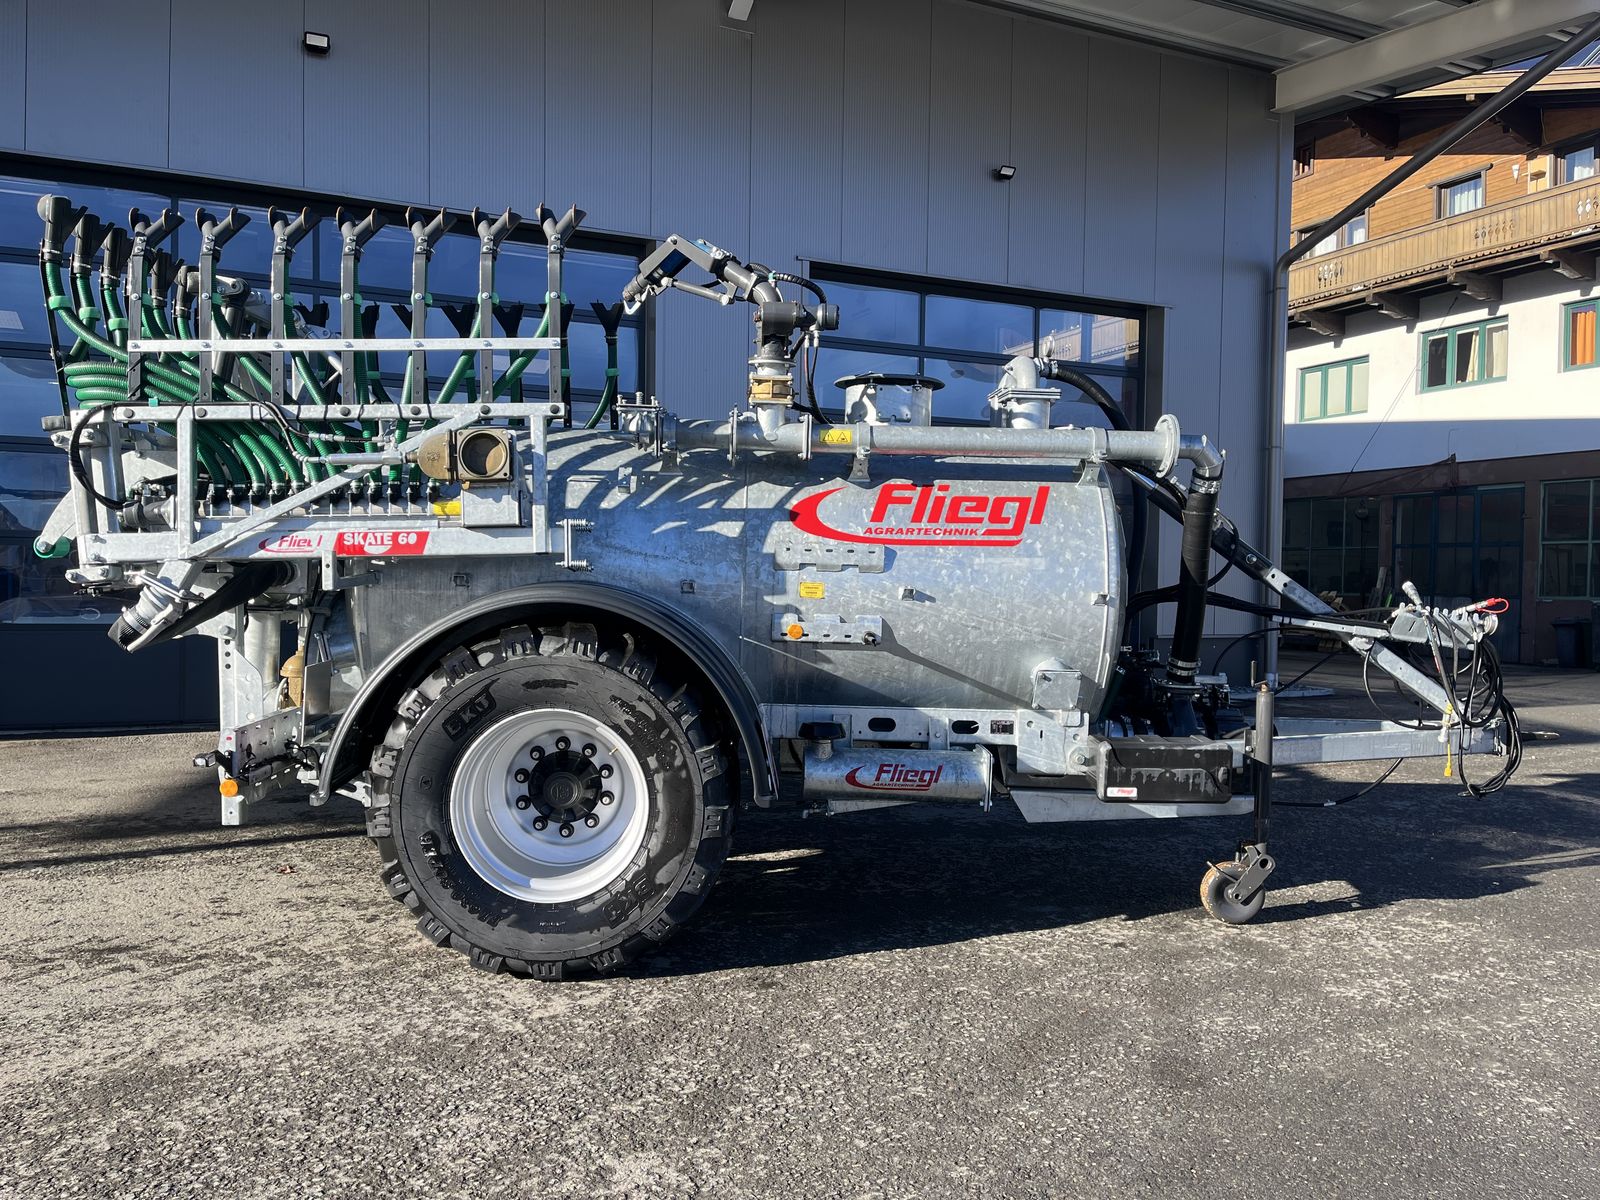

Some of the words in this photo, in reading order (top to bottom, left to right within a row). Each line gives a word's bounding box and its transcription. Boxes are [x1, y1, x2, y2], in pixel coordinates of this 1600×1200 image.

[869, 483, 1050, 537] Fliegl
[343, 532, 393, 546] SKATE
[397, 532, 418, 545] 60
[863, 527, 979, 536] AGRARTECHNIK
[874, 763, 943, 787] Fliegl
